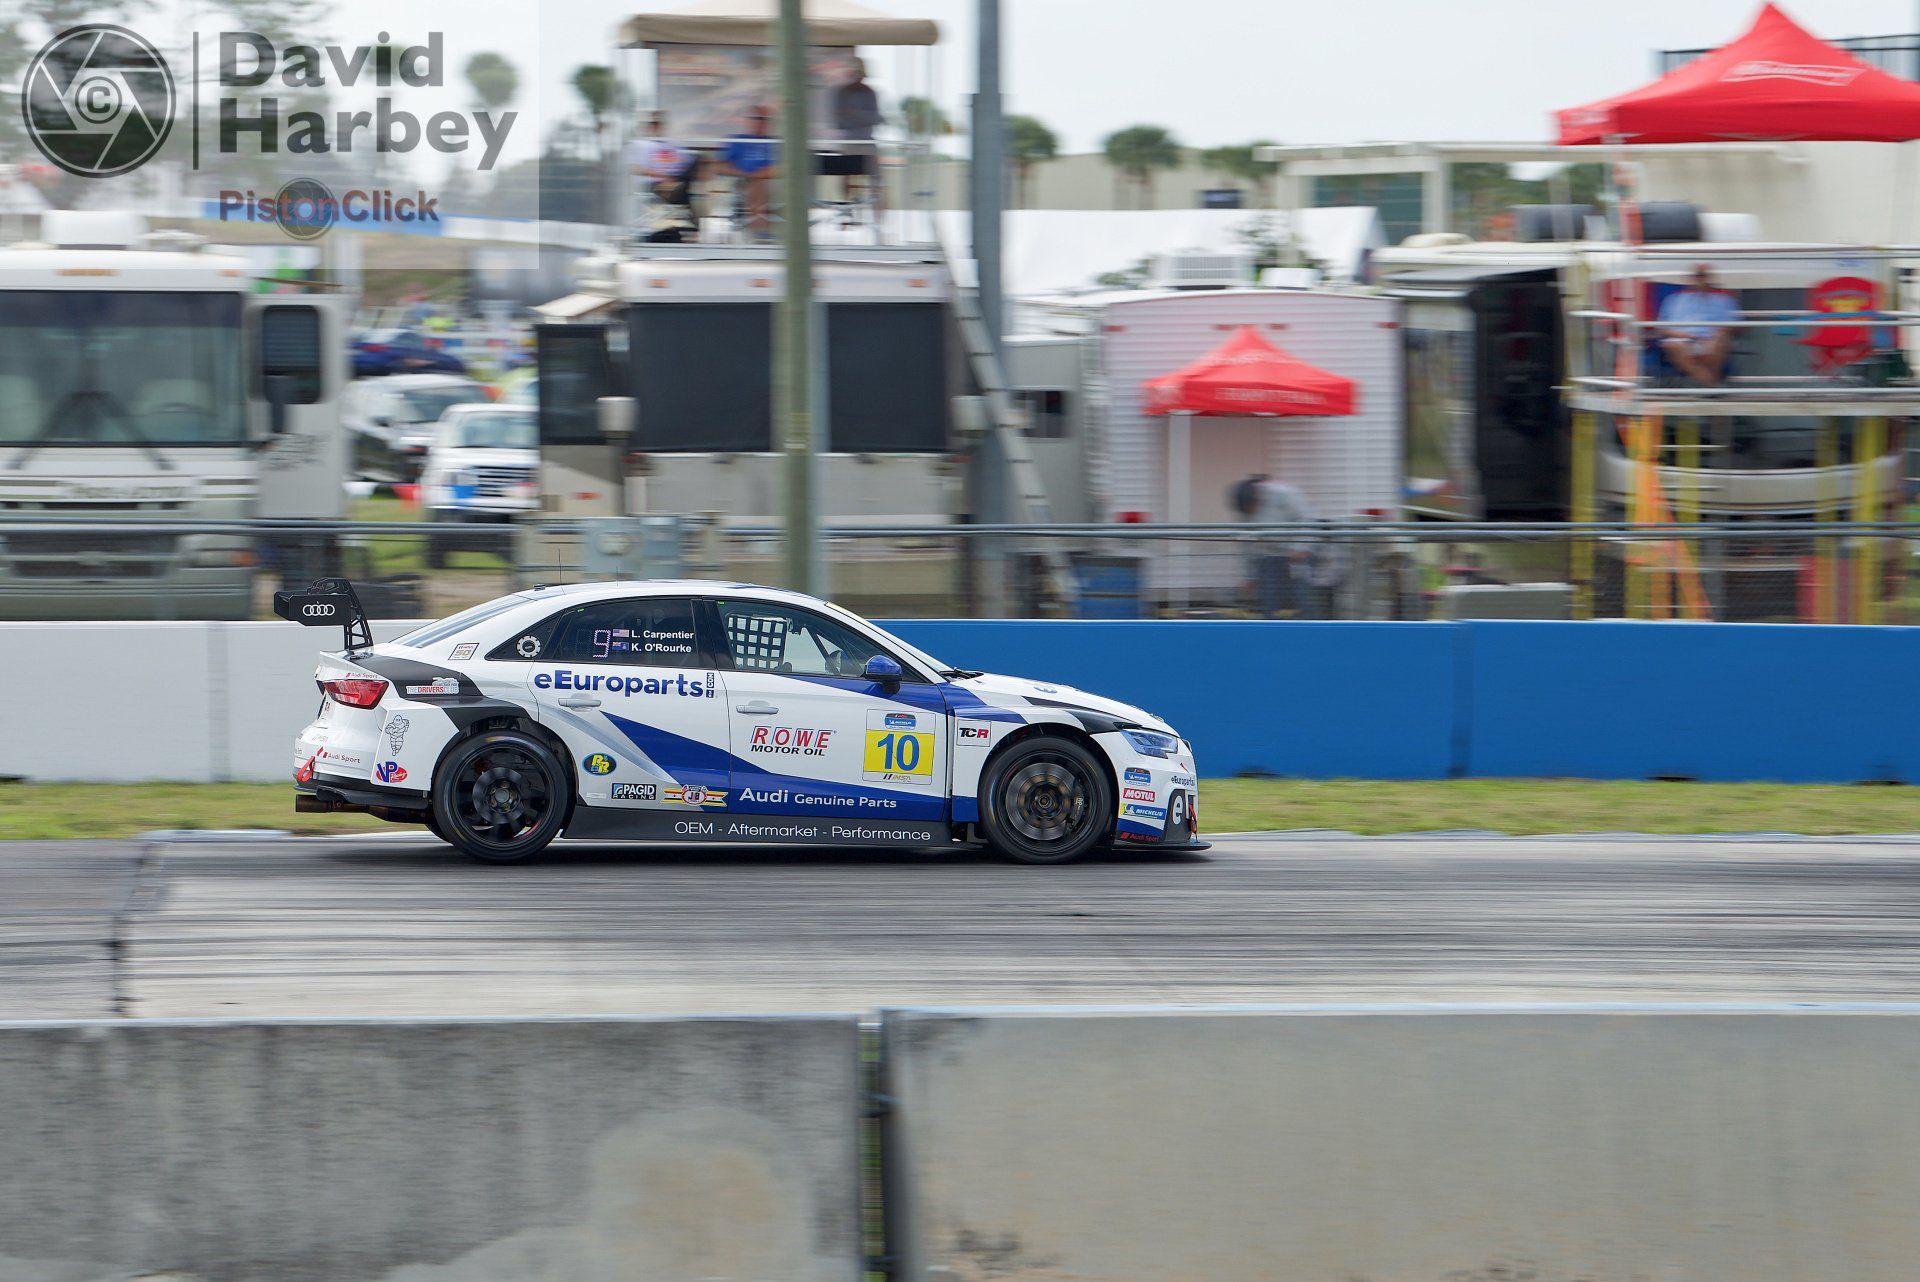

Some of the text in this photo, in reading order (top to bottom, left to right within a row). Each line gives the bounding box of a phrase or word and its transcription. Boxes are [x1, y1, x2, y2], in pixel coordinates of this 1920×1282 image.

[631, 630, 694, 640] L. Carpentier
[631, 643, 692, 653] K. O'Rourke
[534, 670, 704, 698] eEuroparts
[751, 726, 832, 749] ROWE
[959, 728, 989, 738] TCR
[751, 745, 825, 756] MOTOR OIL
[878, 733, 920, 771] 10
[341, 755, 361, 763] Sport
[377, 761, 398, 783] VP
[623, 784, 655, 795] PAGID
[739, 788, 897, 808] Audi Genuine Parts
[1125, 790, 1154, 801] MOTUL
[1135, 809, 1163, 817] MICHELIN
[675, 821, 713, 834] OEM
[728, 823, 818, 837] Aftermarket
[832, 826, 931, 841] Performance
